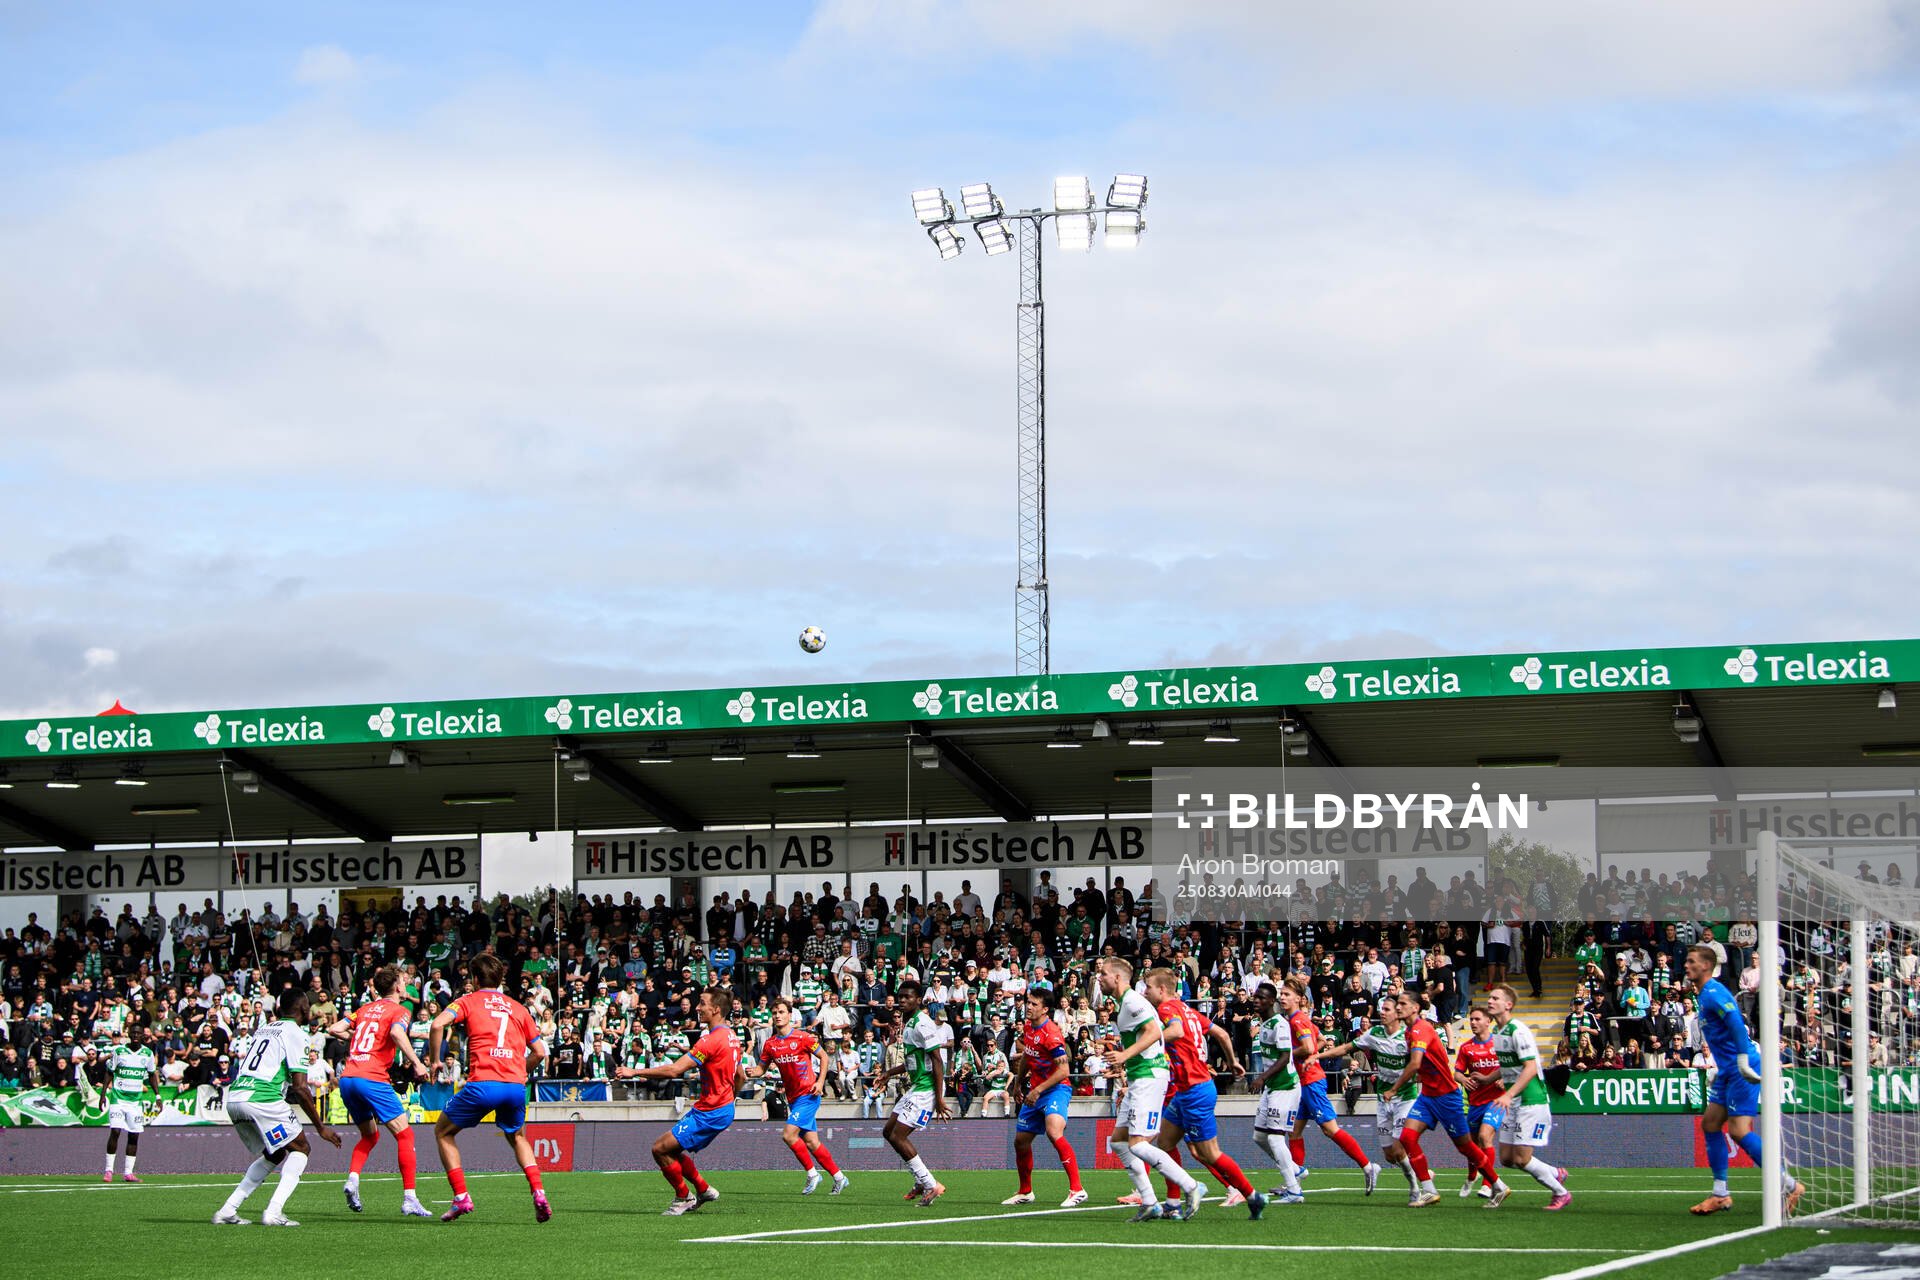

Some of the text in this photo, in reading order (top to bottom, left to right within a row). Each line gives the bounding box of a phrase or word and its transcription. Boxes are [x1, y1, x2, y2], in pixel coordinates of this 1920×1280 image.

[1549, 659, 1670, 688] Telexia
[1765, 651, 1890, 680] Telexia
[1145, 676, 1258, 705] Telexia
[1343, 667, 1460, 696] Telexia
[762, 693, 868, 720] Telexia
[949, 684, 1058, 713] Telexia
[227, 716, 325, 742] Telexia
[401, 708, 502, 735] Telexia
[579, 701, 683, 728] Telexia
[57, 723, 152, 750] Telexia
[611, 835, 766, 873] Hisstech
[780, 834, 834, 869] AB
[911, 825, 1074, 864] Hisstech
[1088, 827, 1145, 861] AB
[136, 854, 185, 887] AB
[255, 846, 402, 884] Hisstech
[415, 846, 467, 881] AB
[350, 1021, 379, 1053] 16
[491, 1010, 509, 1048] 7
[240, 1038, 270, 1071] 18
